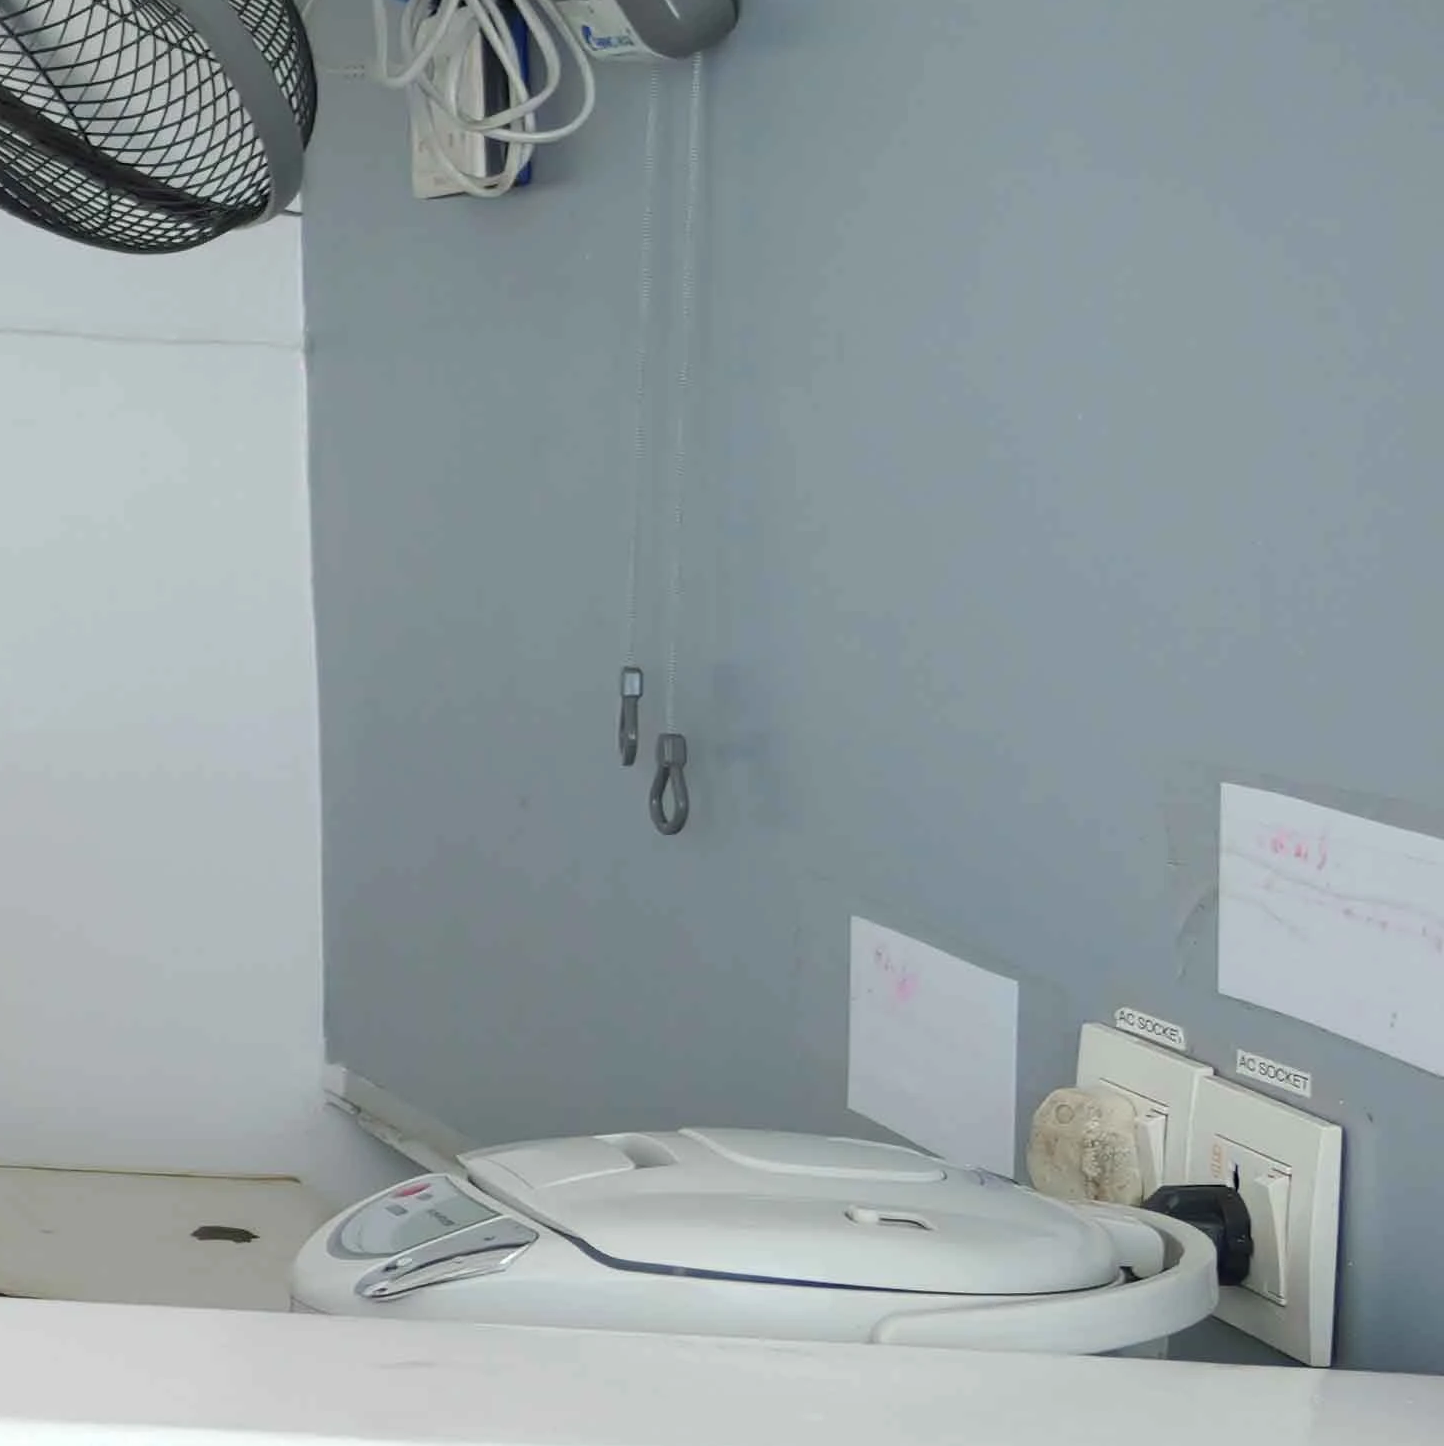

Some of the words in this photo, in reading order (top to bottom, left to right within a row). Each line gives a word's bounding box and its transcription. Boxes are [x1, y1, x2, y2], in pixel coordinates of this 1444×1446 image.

[1117, 1009, 1135, 1027] AC
[1238, 1055, 1256, 1072] AC
[1259, 1061, 1309, 1091] SOCKET
